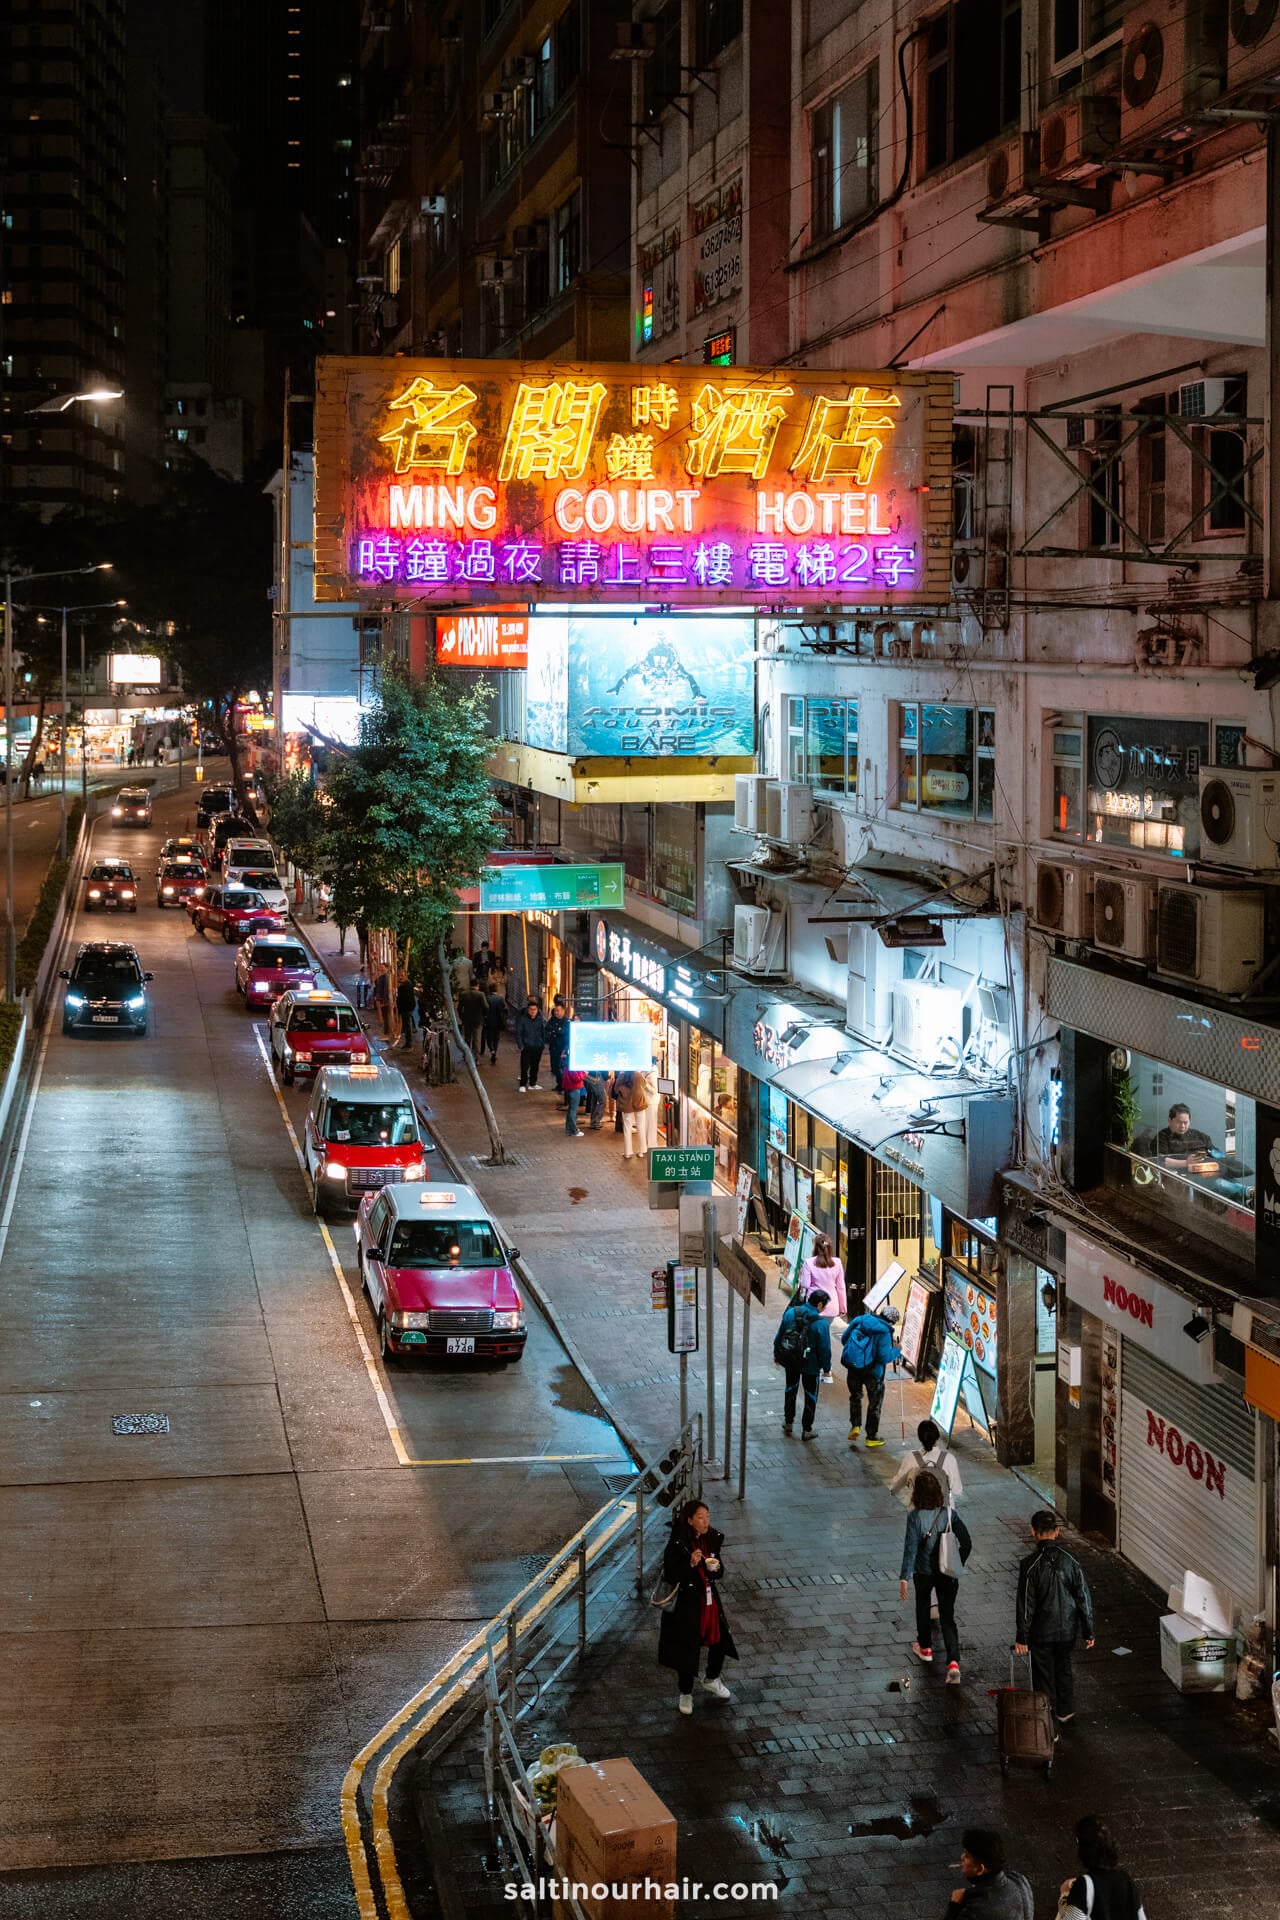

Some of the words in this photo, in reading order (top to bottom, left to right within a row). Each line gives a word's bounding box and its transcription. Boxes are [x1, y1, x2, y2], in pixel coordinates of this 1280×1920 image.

[378, 377, 607, 481] 名閣
[686, 384, 902, 485] 酒店
[389, 485, 497, 530] MING
[555, 489, 700, 533] COURT
[757, 491, 891, 535] HOTEL
[357, 537, 544, 583] 時鐘過夜
[558, 540, 734, 585] 請上三樓
[749, 542, 915, 586] 電梯2字
[582, 706, 736, 716] ATOMIC
[582, 719, 736, 729] AQUATICS
[621, 735, 696, 751] BARE
[656, 1154, 676, 1163] TAXI
[679, 1153, 711, 1162] STAND
[665, 1166, 701, 1178] 的士站
[1103, 1275, 1154, 1328] NOON
[448, 1344, 473, 1353] 8748
[1146, 1409, 1226, 1500] NOON
